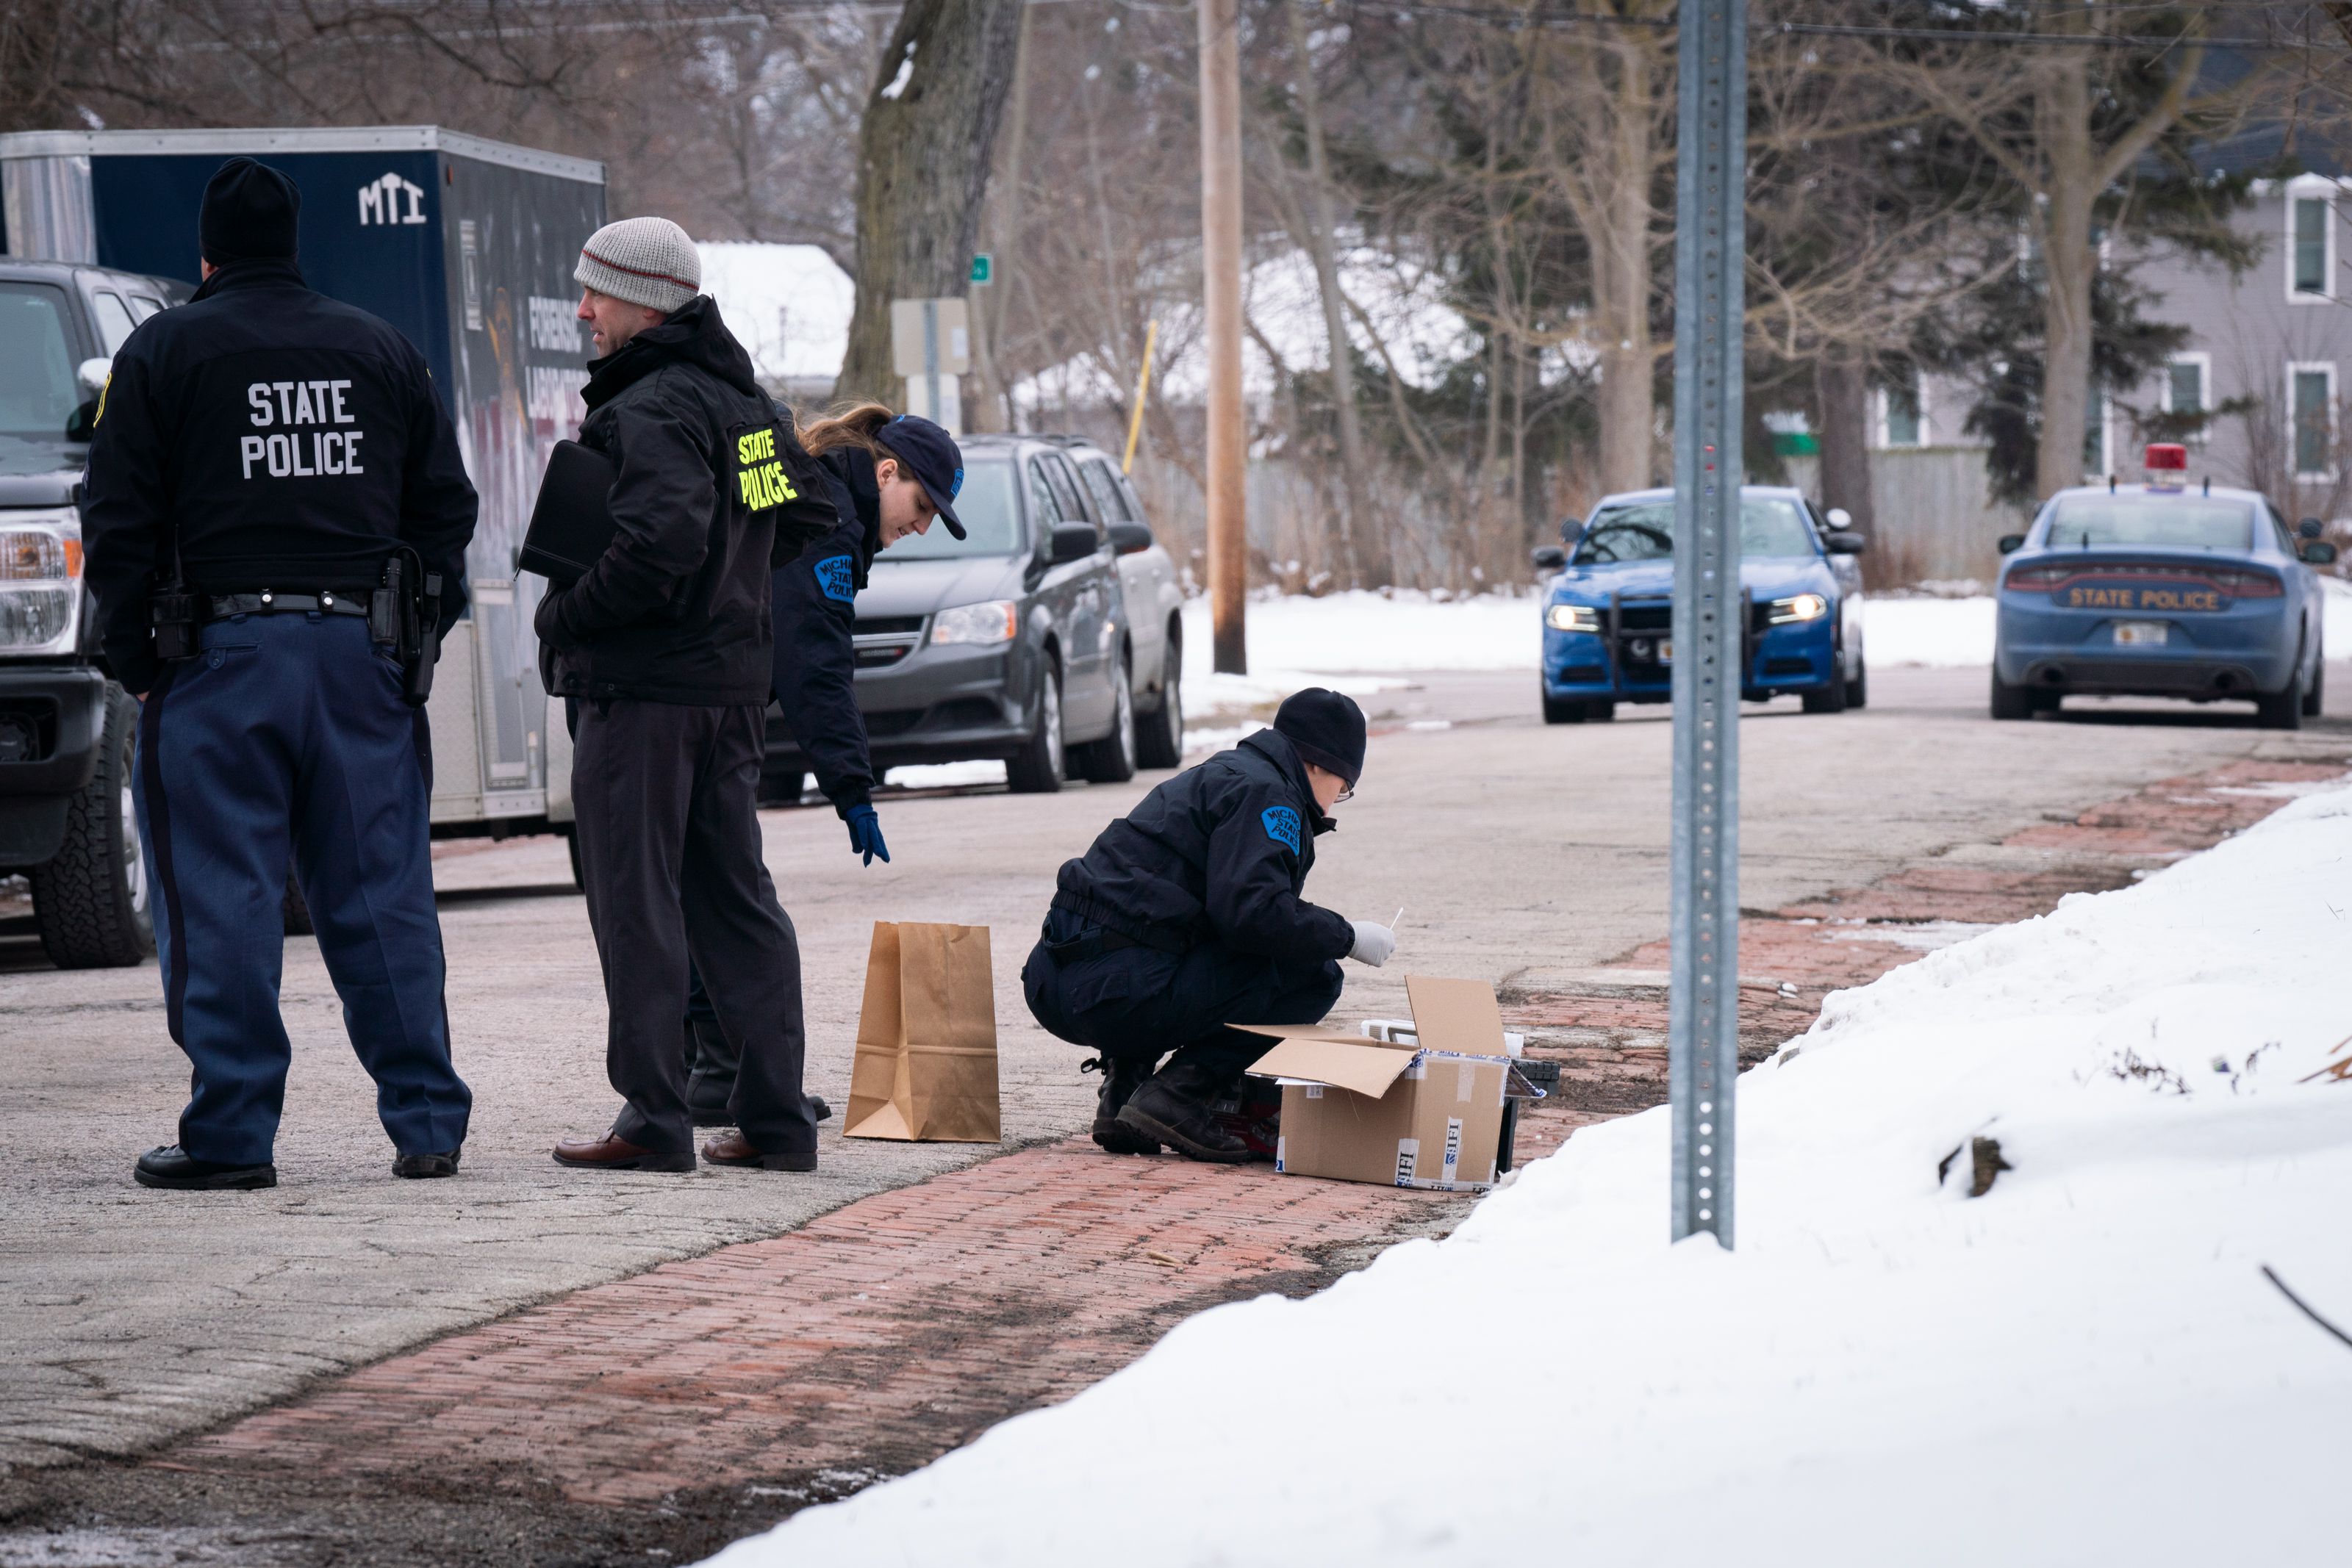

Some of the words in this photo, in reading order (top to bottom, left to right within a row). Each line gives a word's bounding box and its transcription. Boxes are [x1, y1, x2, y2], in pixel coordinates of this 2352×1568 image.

[358, 172, 426, 226] MTI
[247, 379, 355, 427] STATE
[240, 431, 364, 479] POLICE
[738, 428, 775, 464] STATE
[738, 461, 798, 512] POLICE
[820, 558, 852, 576] MICHI
[831, 571, 852, 585] STAT
[827, 581, 853, 597] POLIC
[2069, 587, 2133, 608] STATE
[2140, 590, 2219, 611] POLICE
[1267, 809, 1299, 829] MICHIG
